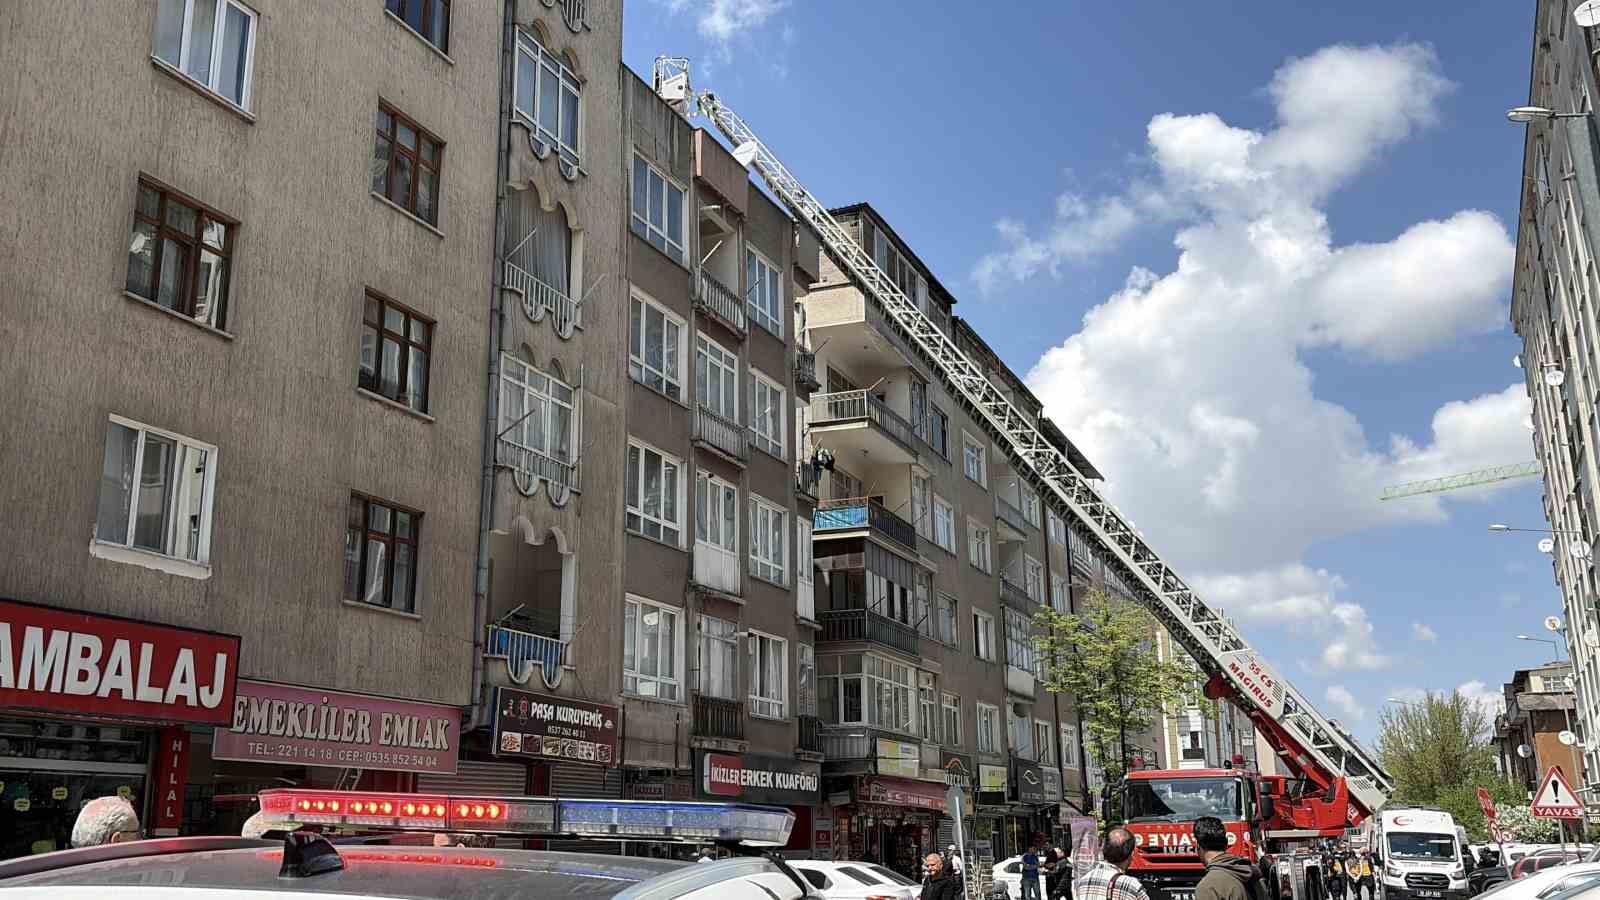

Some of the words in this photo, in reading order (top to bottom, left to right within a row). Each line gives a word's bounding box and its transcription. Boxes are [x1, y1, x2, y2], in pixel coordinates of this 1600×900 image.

[1229, 662, 1274, 708] MAGIRUS
[232, 694, 373, 745] EMEKLİLER
[379, 712, 451, 751] EMLAK
[531, 702, 554, 722] PAŞA
[556, 706, 603, 731] KURUYEMİŞ
[248, 742, 274, 756] TEL:
[277, 744, 299, 759] 221
[338, 750, 362, 763] CEP:
[711, 763, 740, 785] İKİZLER
[739, 769, 773, 788] ERKEK
[775, 771, 818, 791] KUAFÖRÜ
